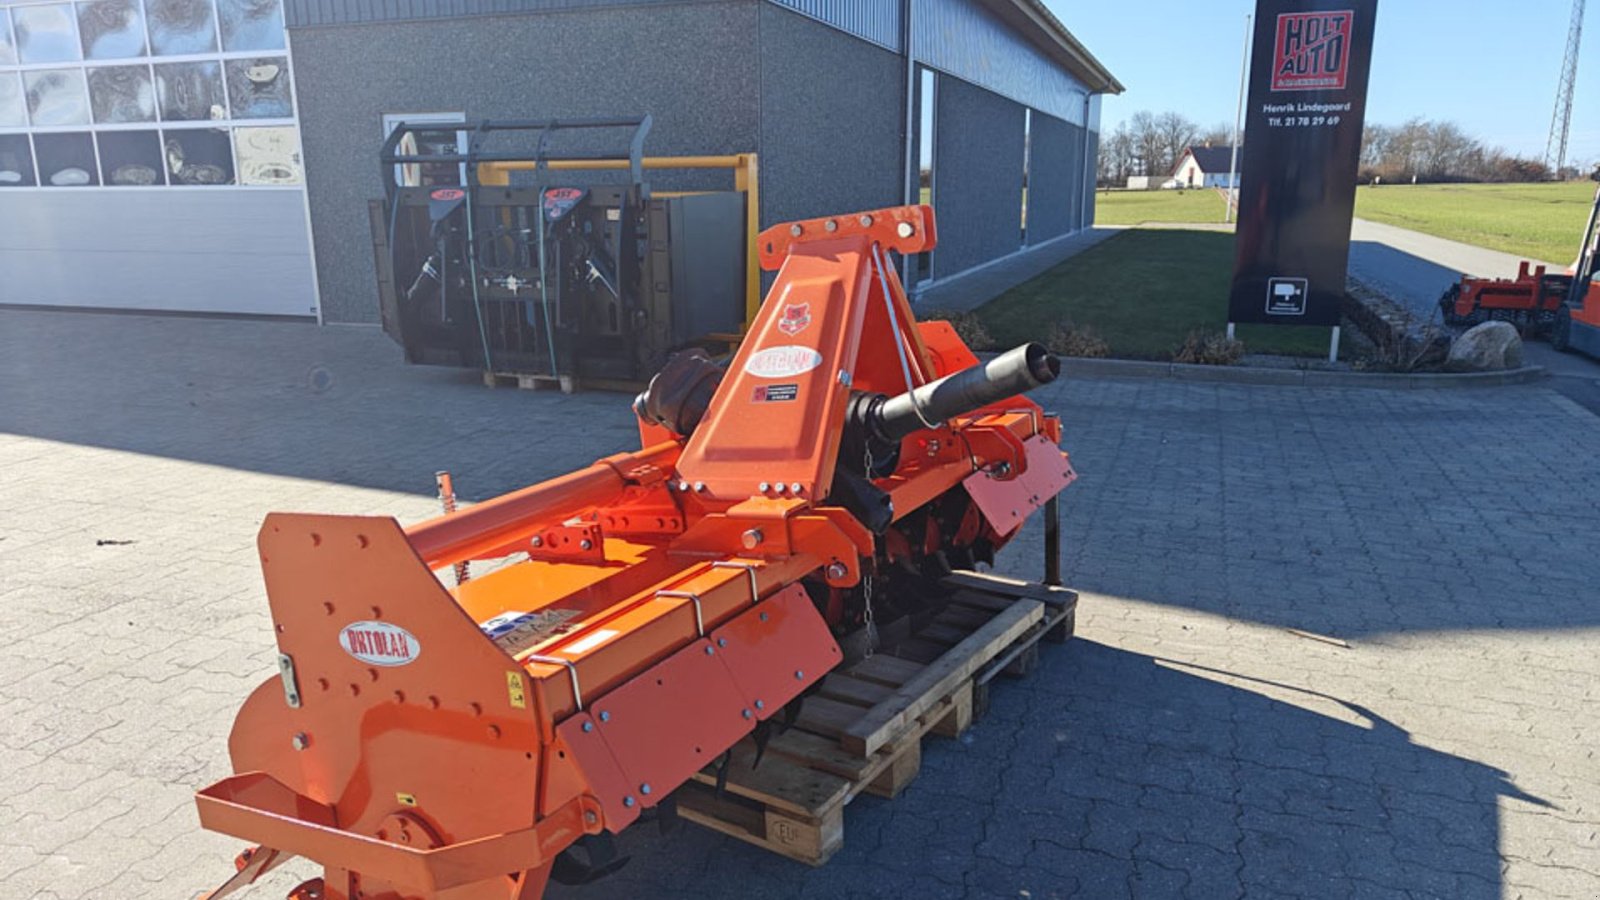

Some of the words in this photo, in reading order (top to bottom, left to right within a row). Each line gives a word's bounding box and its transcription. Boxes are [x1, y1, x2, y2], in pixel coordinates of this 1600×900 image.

[1284, 15, 1345, 57] HOLT
[1279, 33, 1345, 76] AUTO
[1263, 104, 1295, 113] Henrik
[1297, 102, 1351, 113] Lindegaard
[1285, 116, 1296, 127] 21
[1298, 116, 1310, 127] 78
[1312, 116, 1325, 126] 29
[1327, 115, 1340, 126] 69
